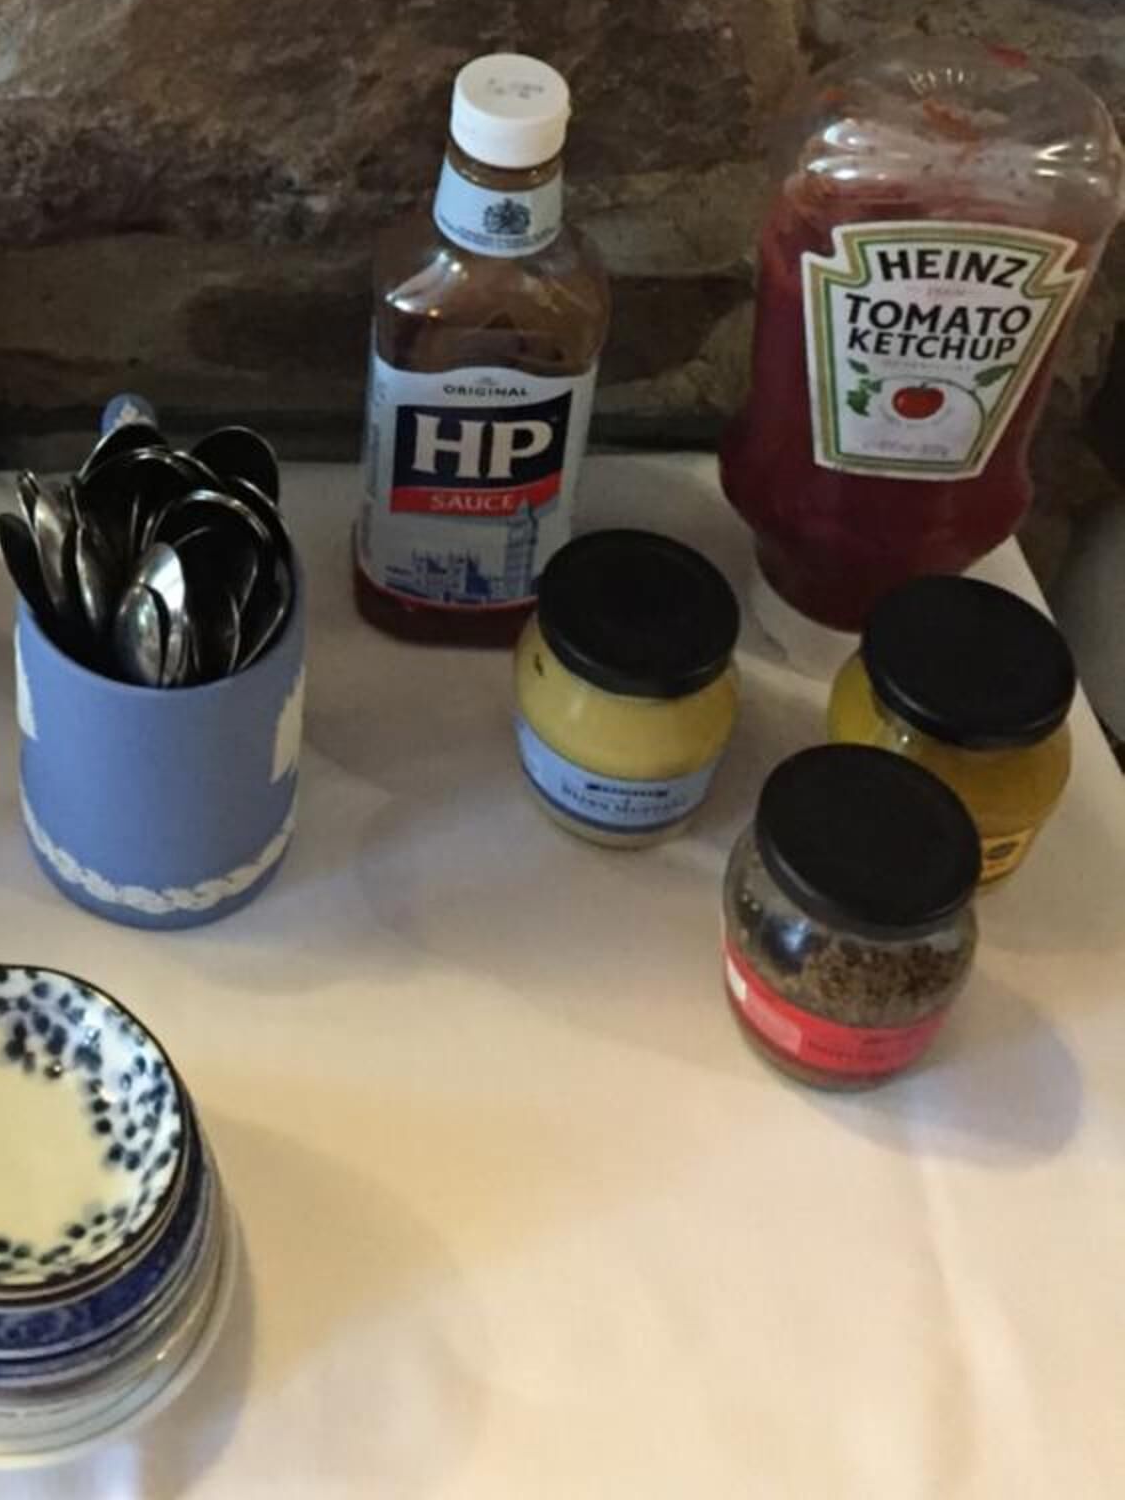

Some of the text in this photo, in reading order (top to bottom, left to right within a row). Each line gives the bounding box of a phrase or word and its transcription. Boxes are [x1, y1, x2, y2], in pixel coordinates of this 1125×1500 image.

[877, 248, 1029, 288] HEINZ
[844, 292, 1032, 337] TOMATO
[847, 327, 1017, 360] KETCHUP
[442, 384, 529, 397] ORIGINAL
[410, 412, 554, 479] HP
[430, 493, 517, 511] SAUCE
